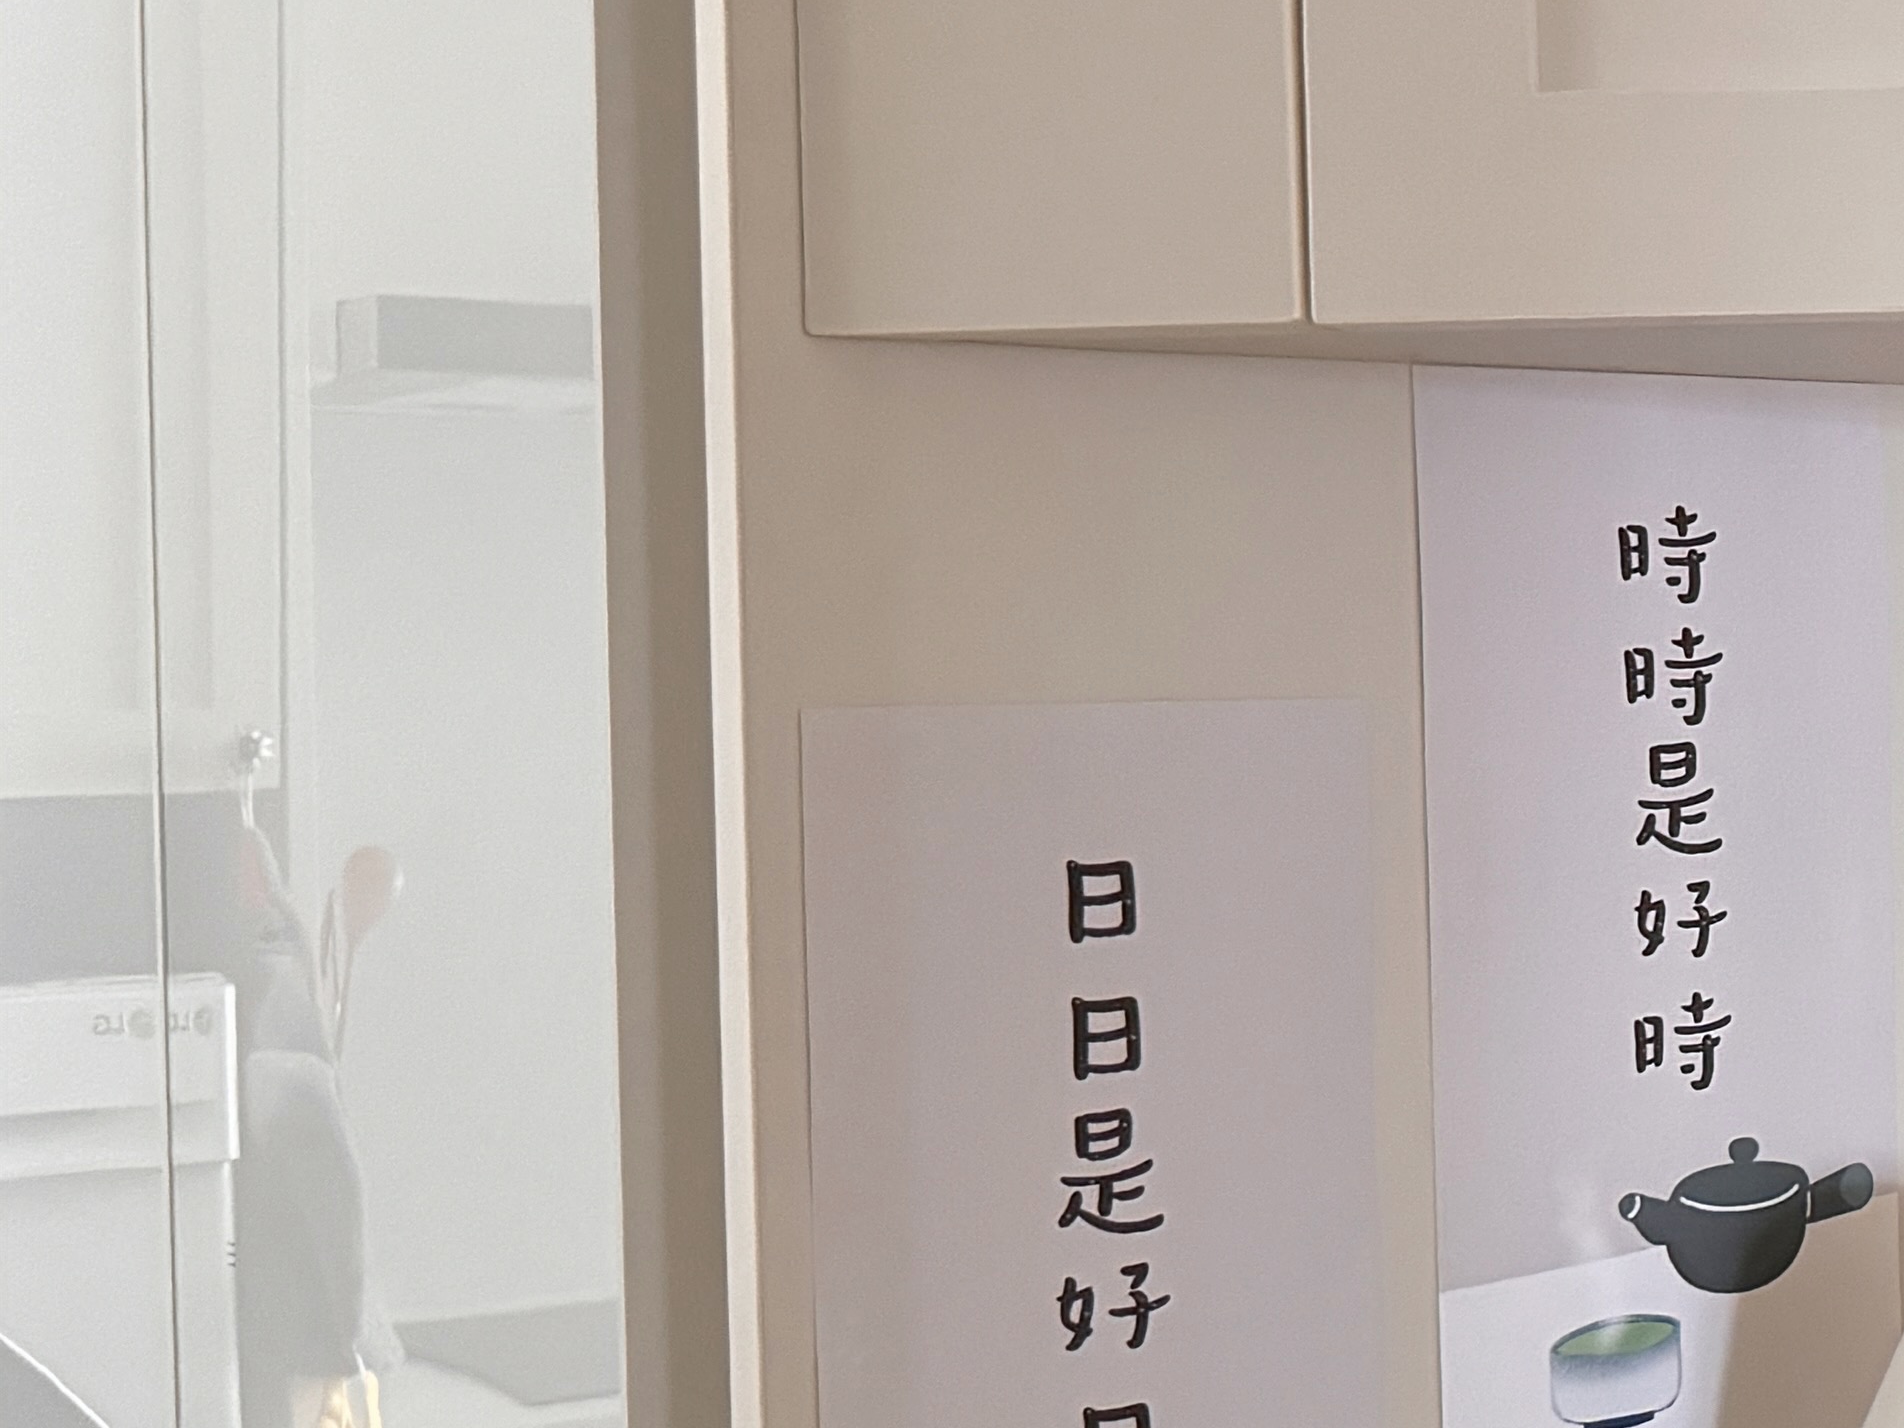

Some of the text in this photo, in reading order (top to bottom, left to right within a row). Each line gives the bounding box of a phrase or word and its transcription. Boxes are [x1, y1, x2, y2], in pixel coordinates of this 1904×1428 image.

[1615, 504, 1734, 1093] 時時是好時
